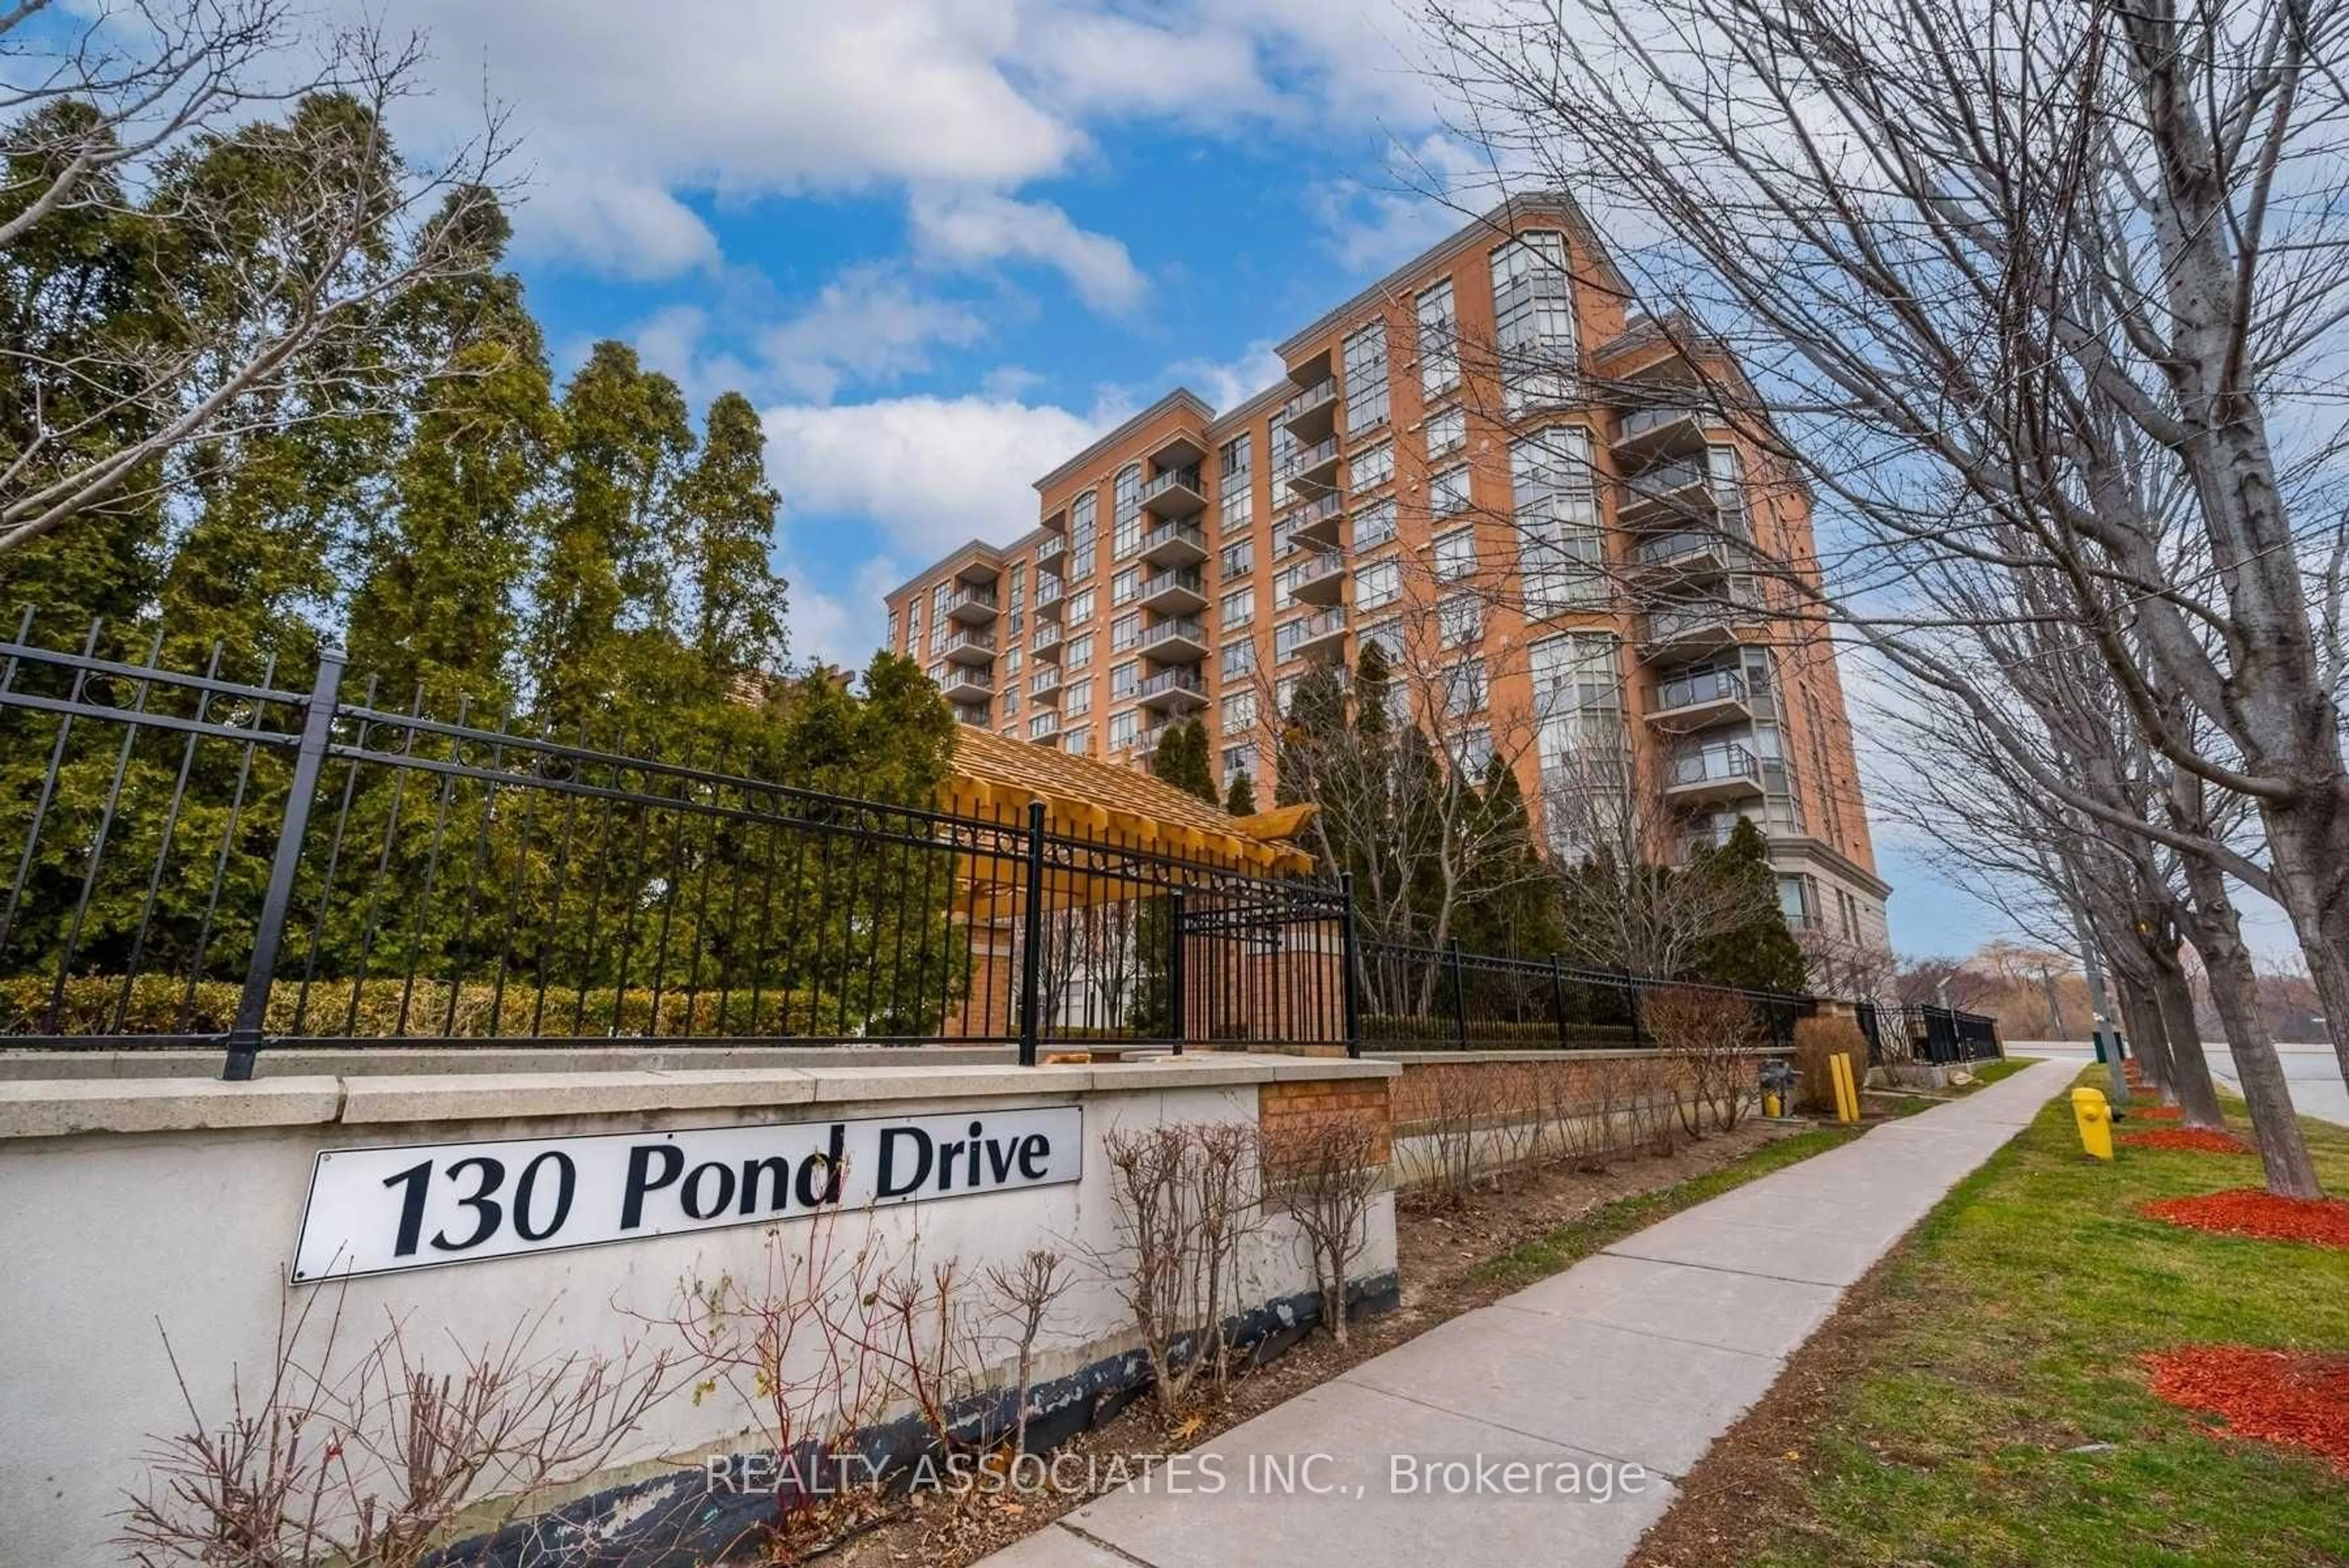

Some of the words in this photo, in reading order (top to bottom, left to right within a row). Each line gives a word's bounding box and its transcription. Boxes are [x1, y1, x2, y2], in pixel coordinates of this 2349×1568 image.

[383, 1150, 576, 1257] 130
[620, 1124, 845, 1230] Pond
[876, 1120, 1051, 1197] Drive
